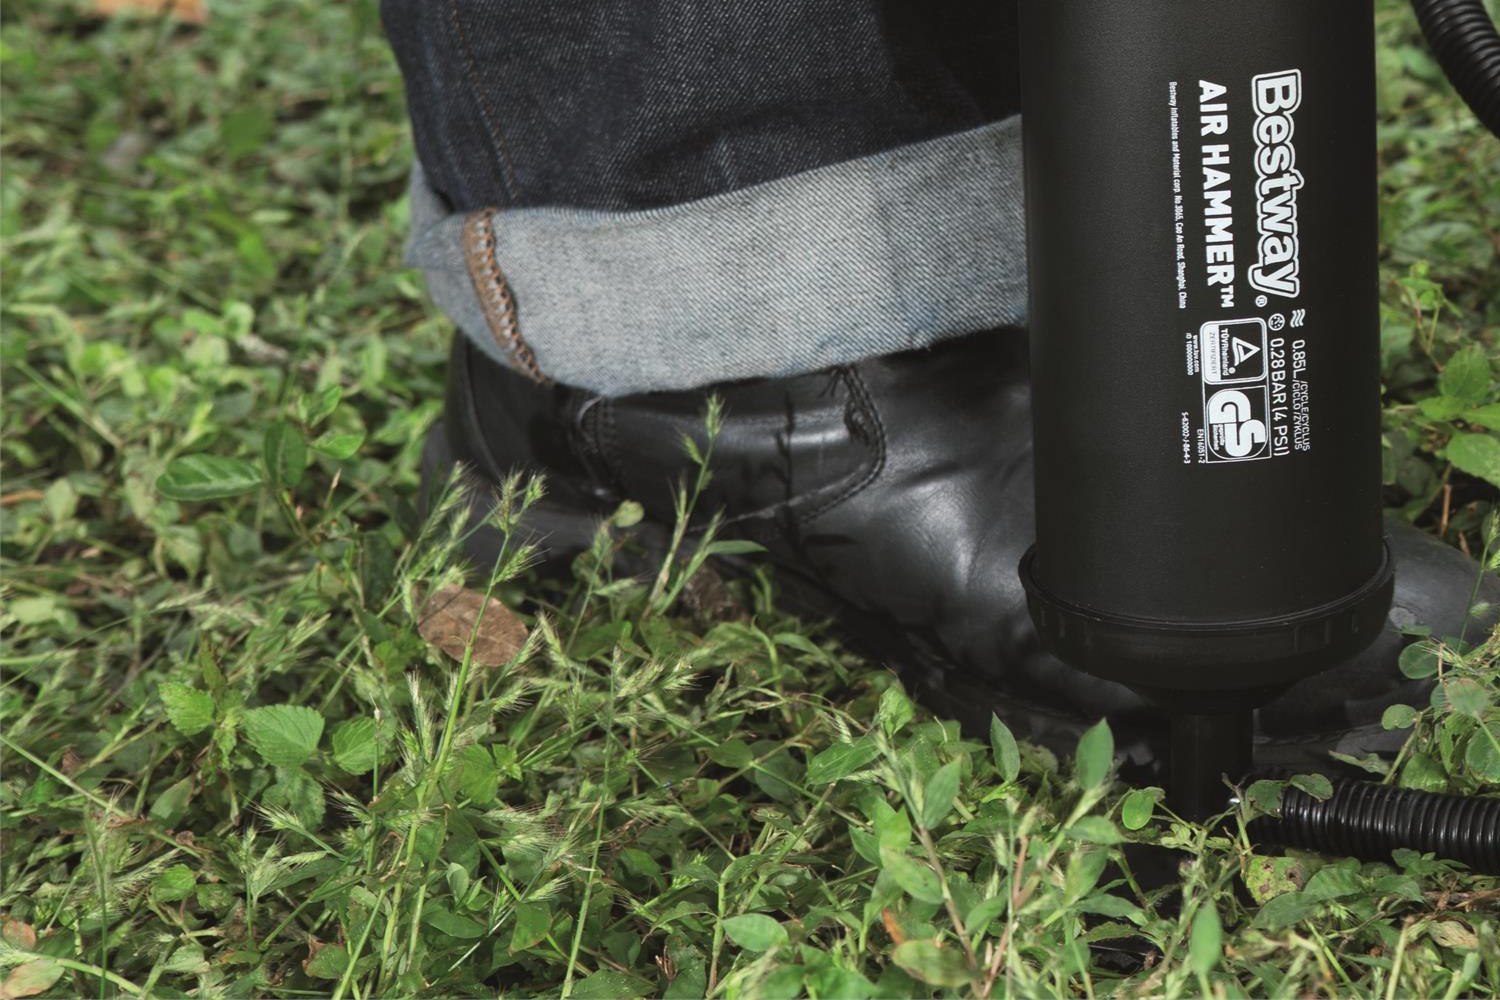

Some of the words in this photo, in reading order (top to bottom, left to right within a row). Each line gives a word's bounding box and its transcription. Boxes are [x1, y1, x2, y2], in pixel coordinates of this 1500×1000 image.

[1198, 80, 1228, 136] AIR
[1270, 338, 1285, 369] 0.28
[1292, 340, 1306, 378] 0.85L
[1271, 371, 1286, 404] BAR
